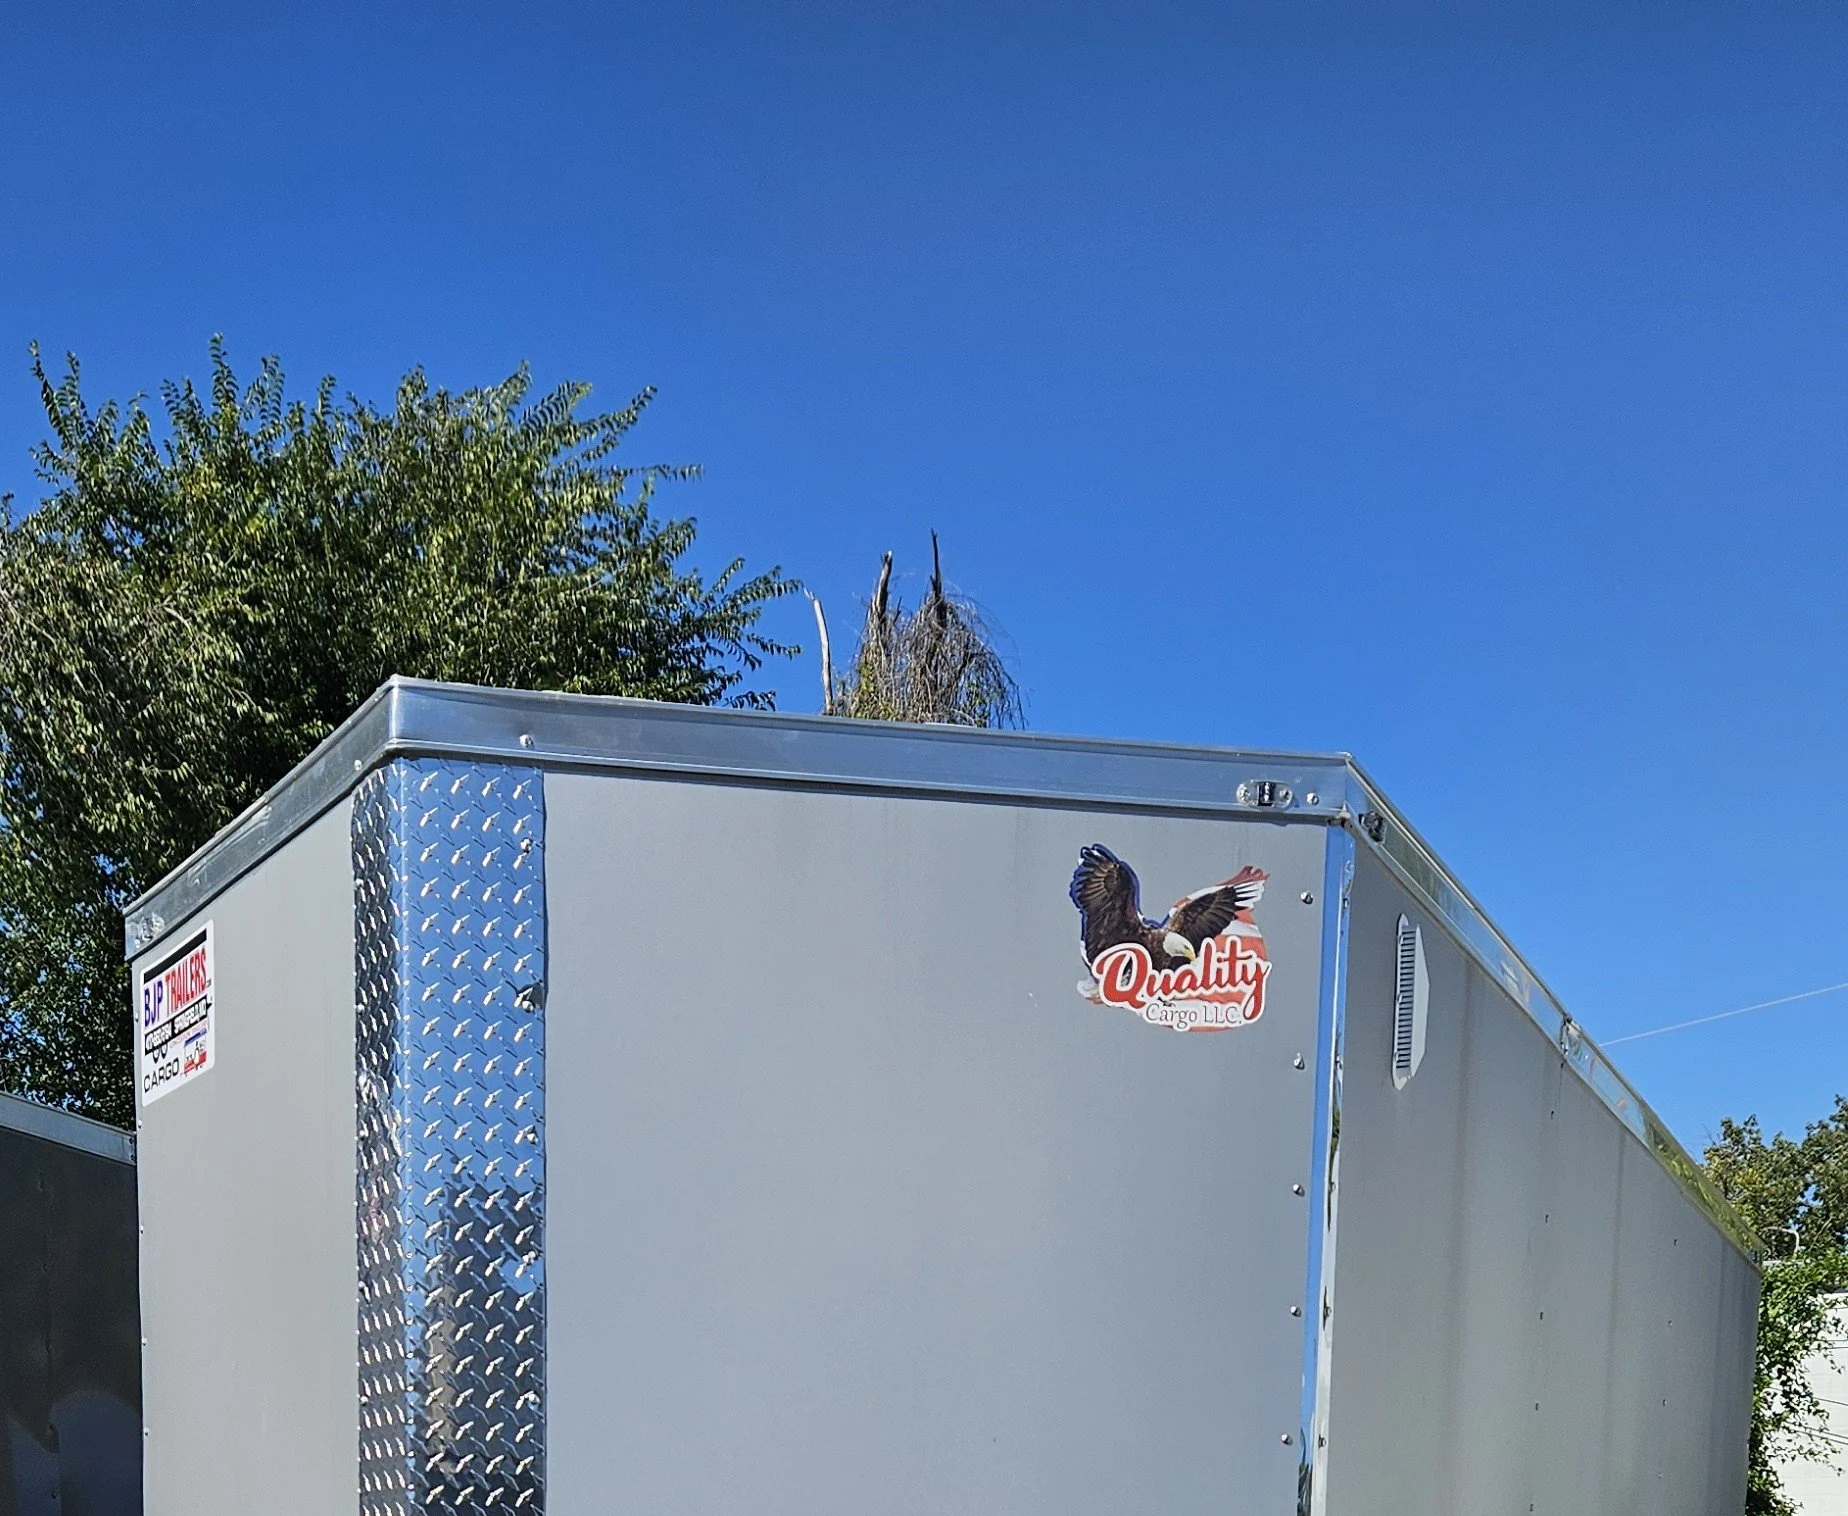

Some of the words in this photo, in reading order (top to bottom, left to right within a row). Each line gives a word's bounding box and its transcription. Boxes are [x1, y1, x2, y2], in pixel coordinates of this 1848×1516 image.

[144, 979, 163, 1027] BJP
[165, 947, 207, 1018] TRAILERS
[1096, 940, 1267, 1021] Quality
[1146, 1003, 1198, 1029] Cargo
[144, 1057, 179, 1093] CARGO
